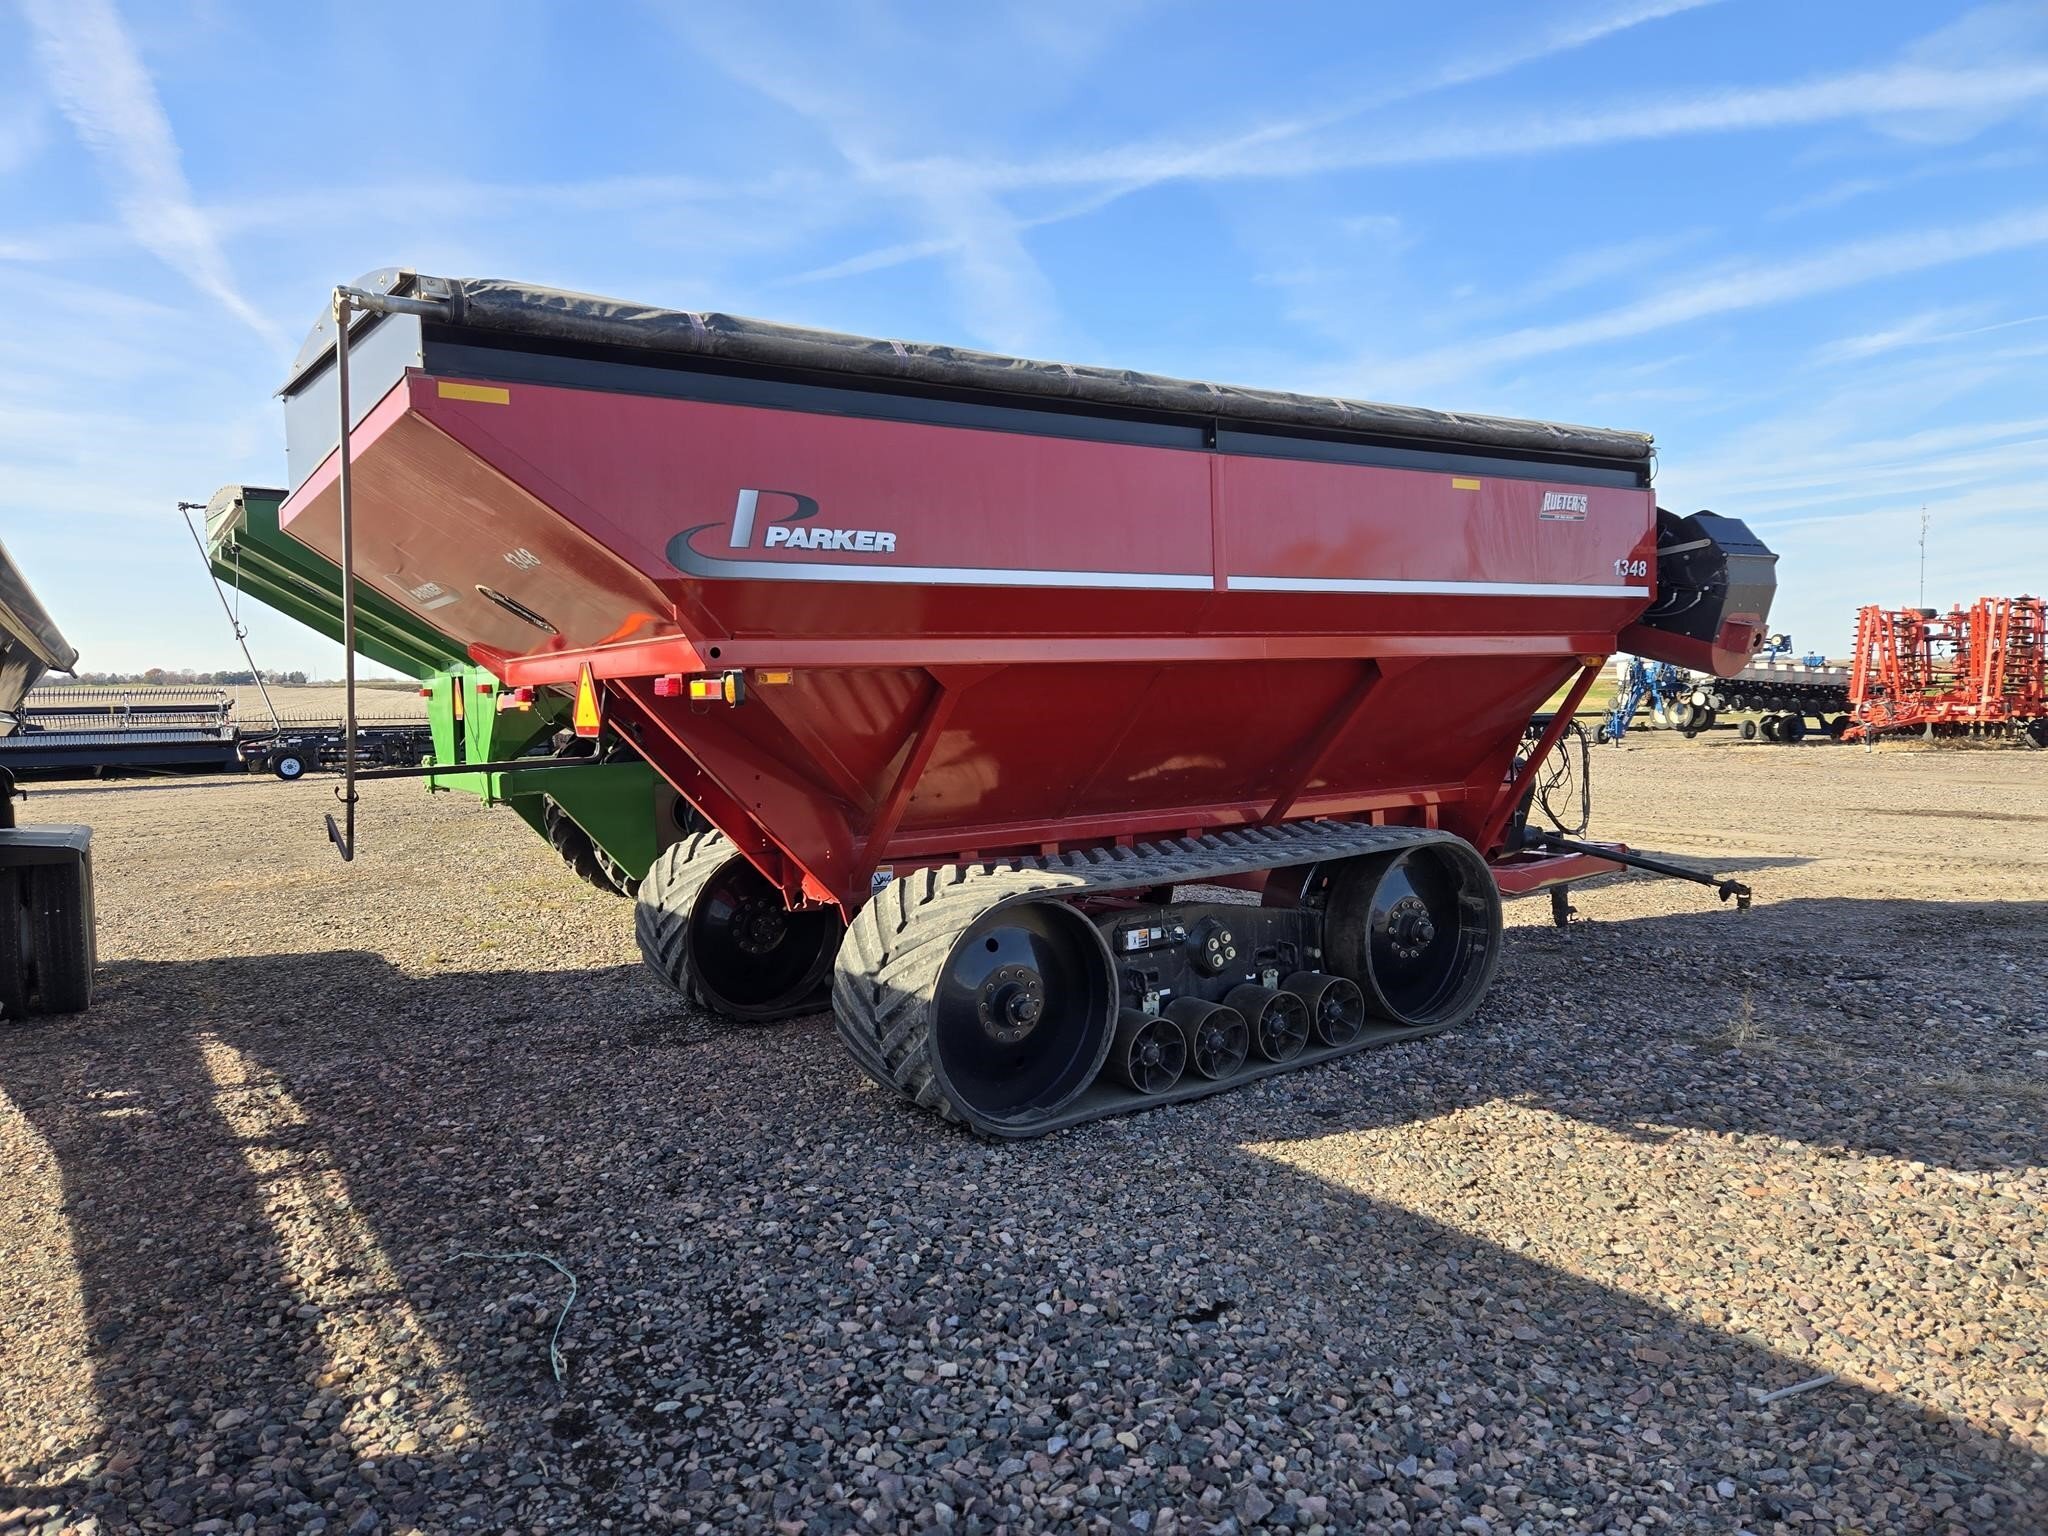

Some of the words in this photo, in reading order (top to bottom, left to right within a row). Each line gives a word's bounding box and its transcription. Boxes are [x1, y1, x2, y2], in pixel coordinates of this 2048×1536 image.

[1543, 491, 1587, 513] RUETER'S
[765, 526, 897, 552] PARKER
[1614, 559, 1647, 577] 1348
